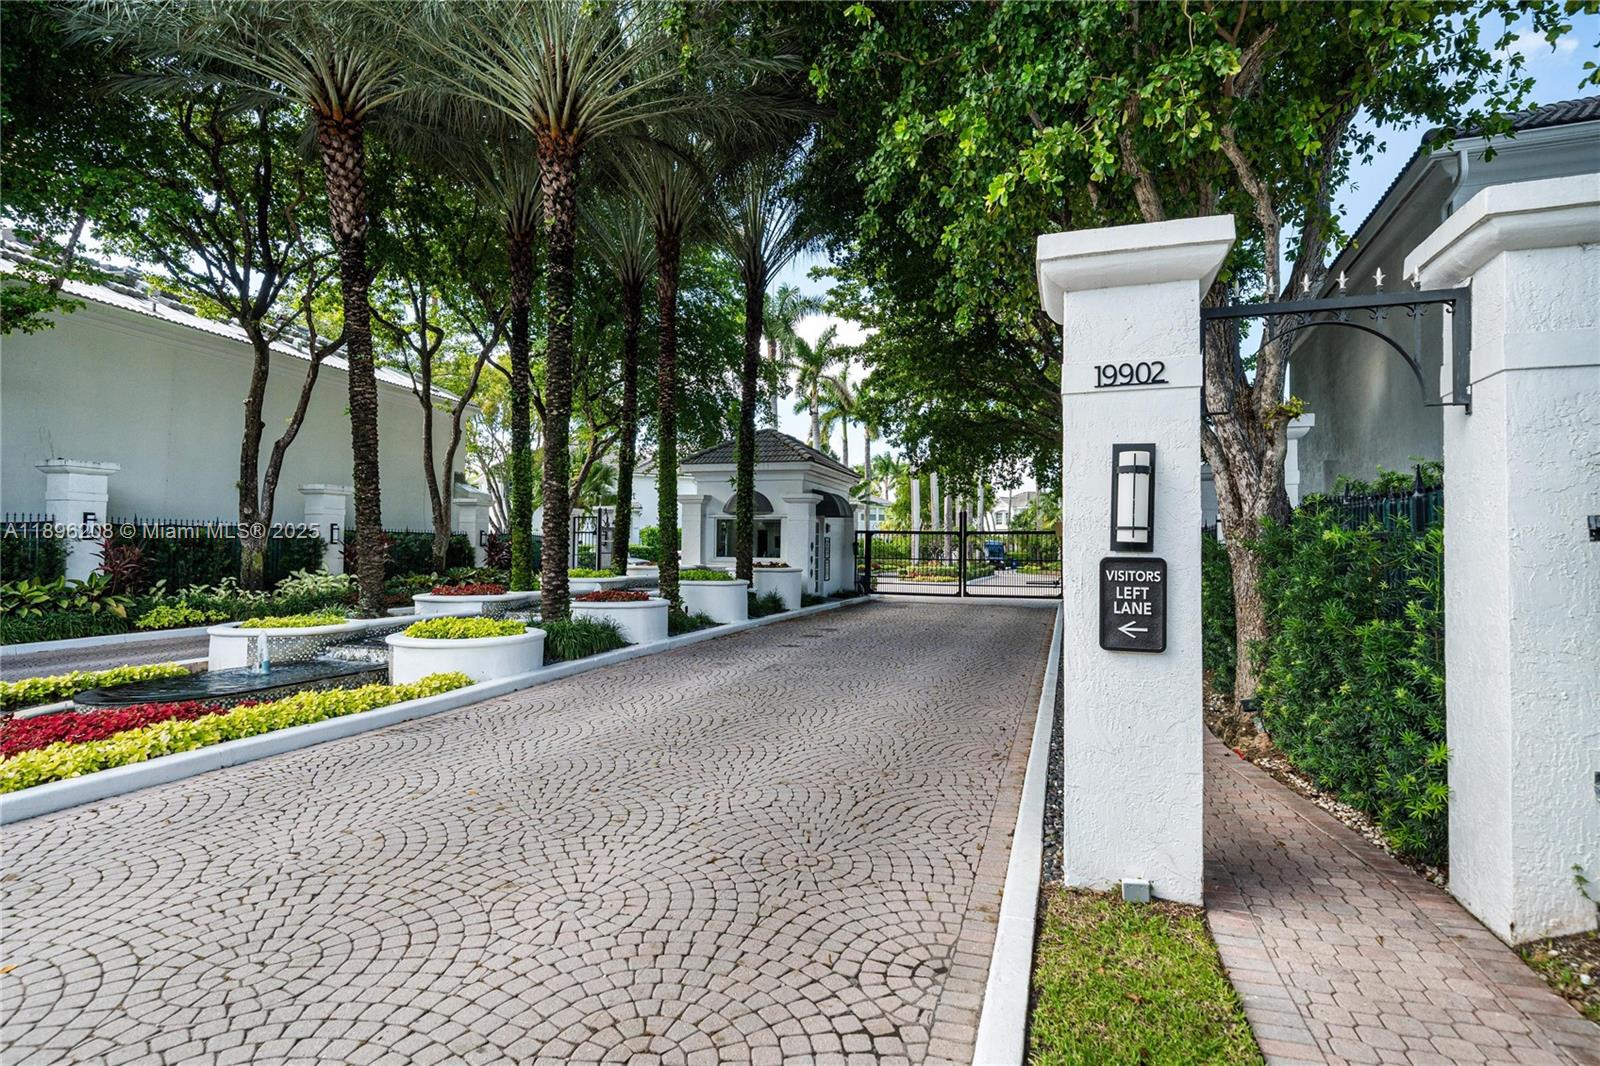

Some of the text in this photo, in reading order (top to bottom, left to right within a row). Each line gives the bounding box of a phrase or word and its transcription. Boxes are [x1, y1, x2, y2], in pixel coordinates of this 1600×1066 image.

[1094, 361, 1168, 388] 19902
[1105, 570, 1161, 582] VISITORS
[1116, 586, 1150, 600] LEFT
[1113, 601, 1152, 615] LANE
